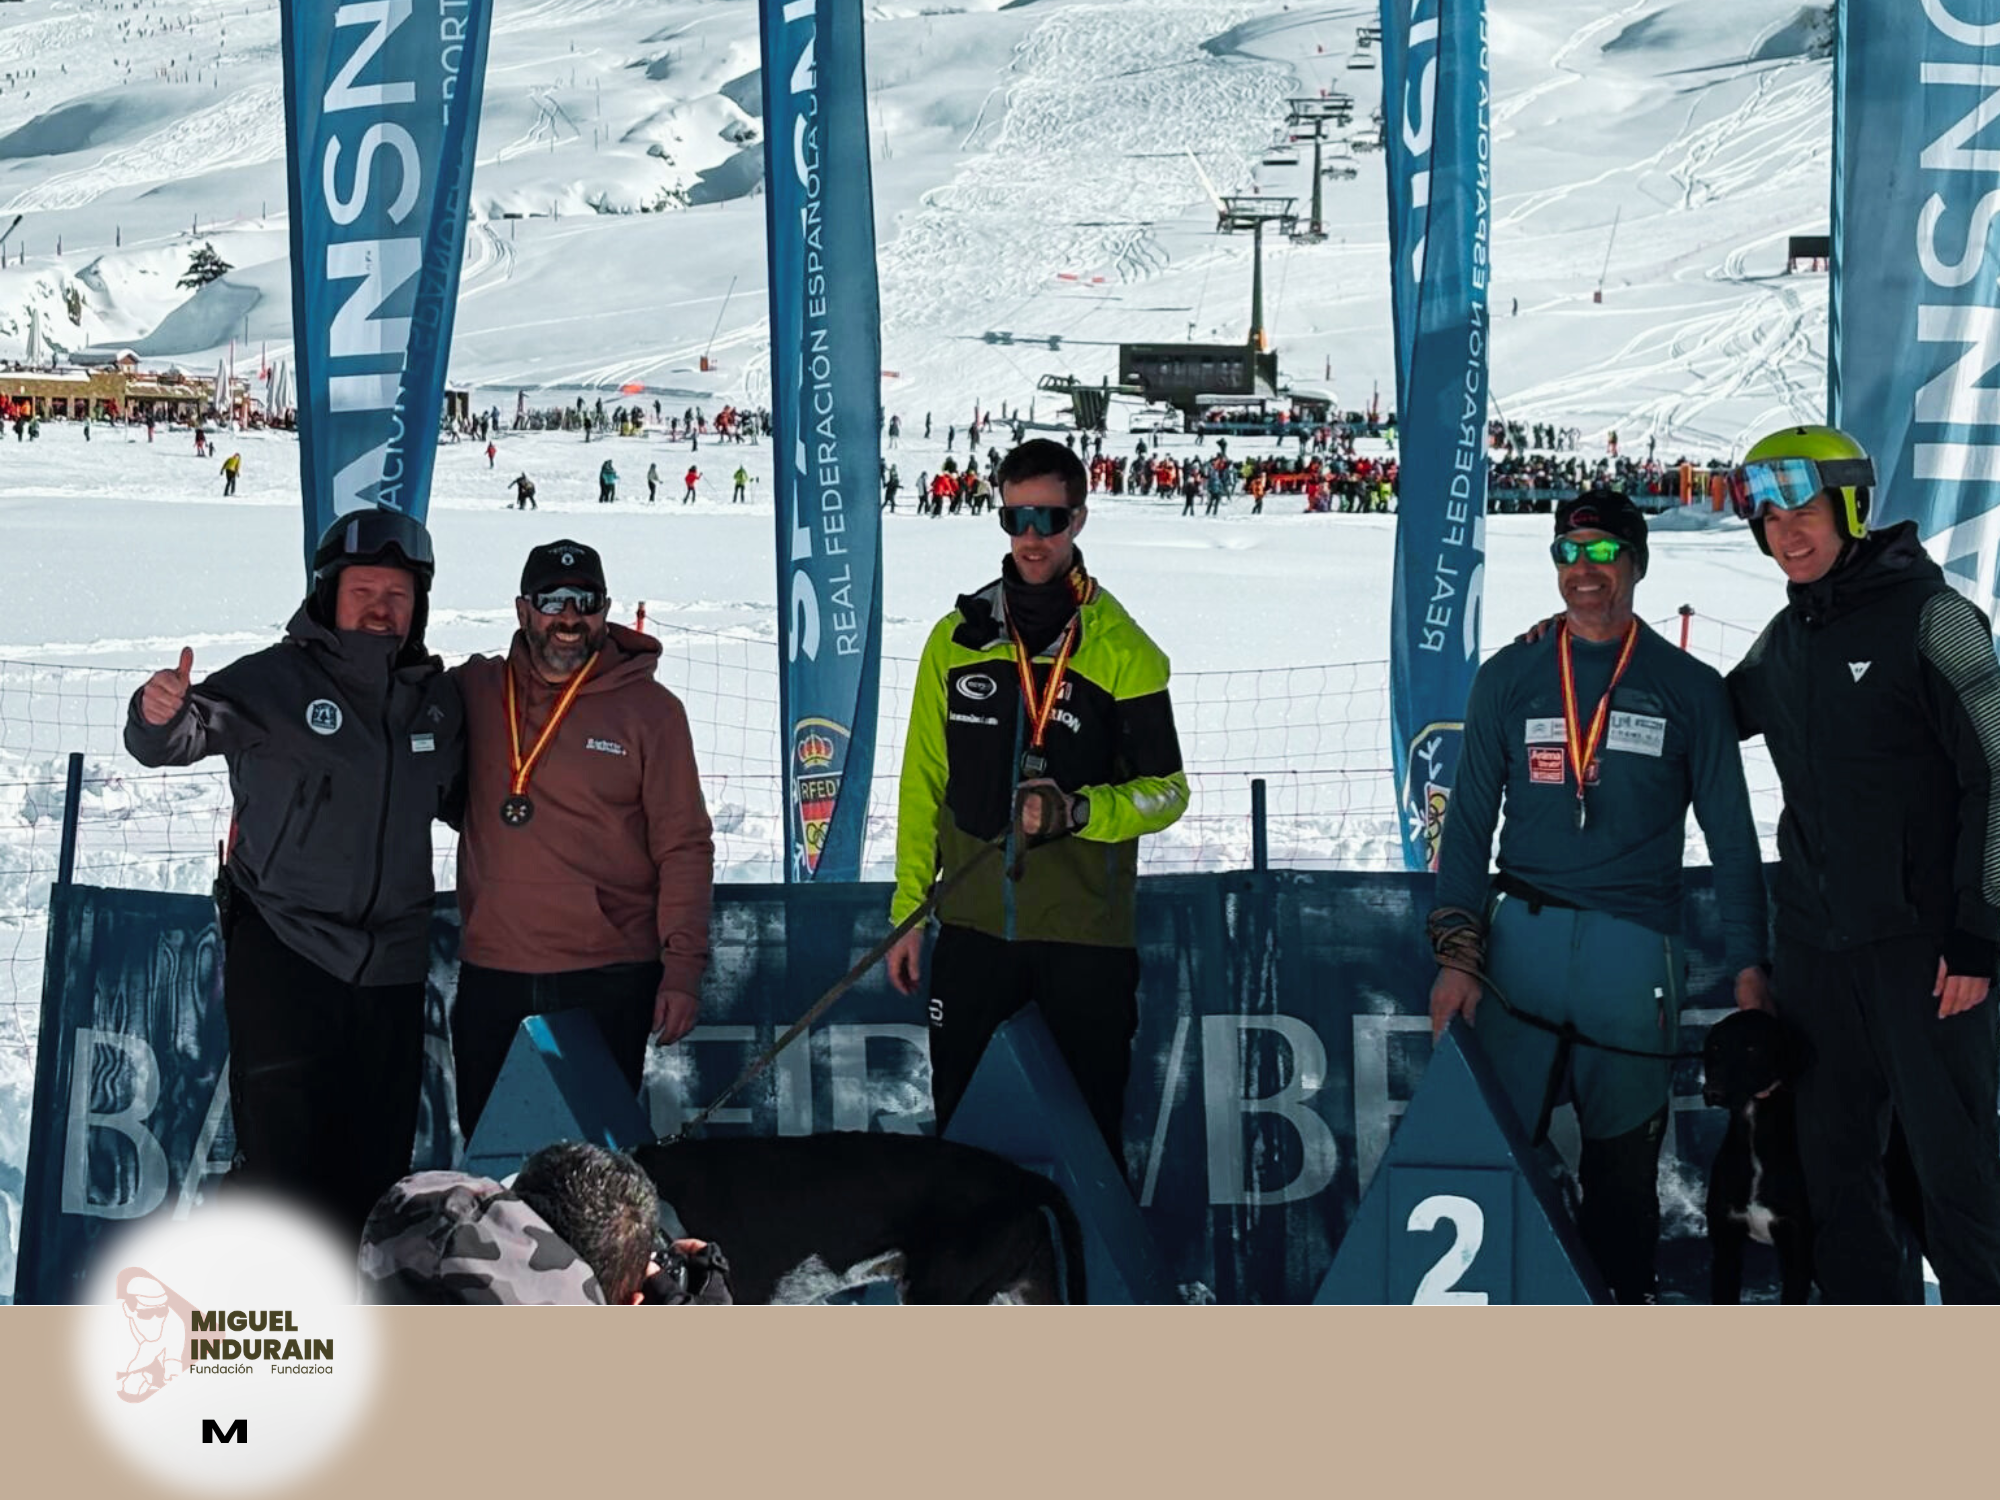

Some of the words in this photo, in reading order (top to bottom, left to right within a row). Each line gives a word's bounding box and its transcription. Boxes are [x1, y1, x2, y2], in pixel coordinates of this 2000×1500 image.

[808, 329, 848, 556] FEDERACIÓN
[828, 563, 861, 656] REAL
[1406, 1195, 1489, 1306] 2
